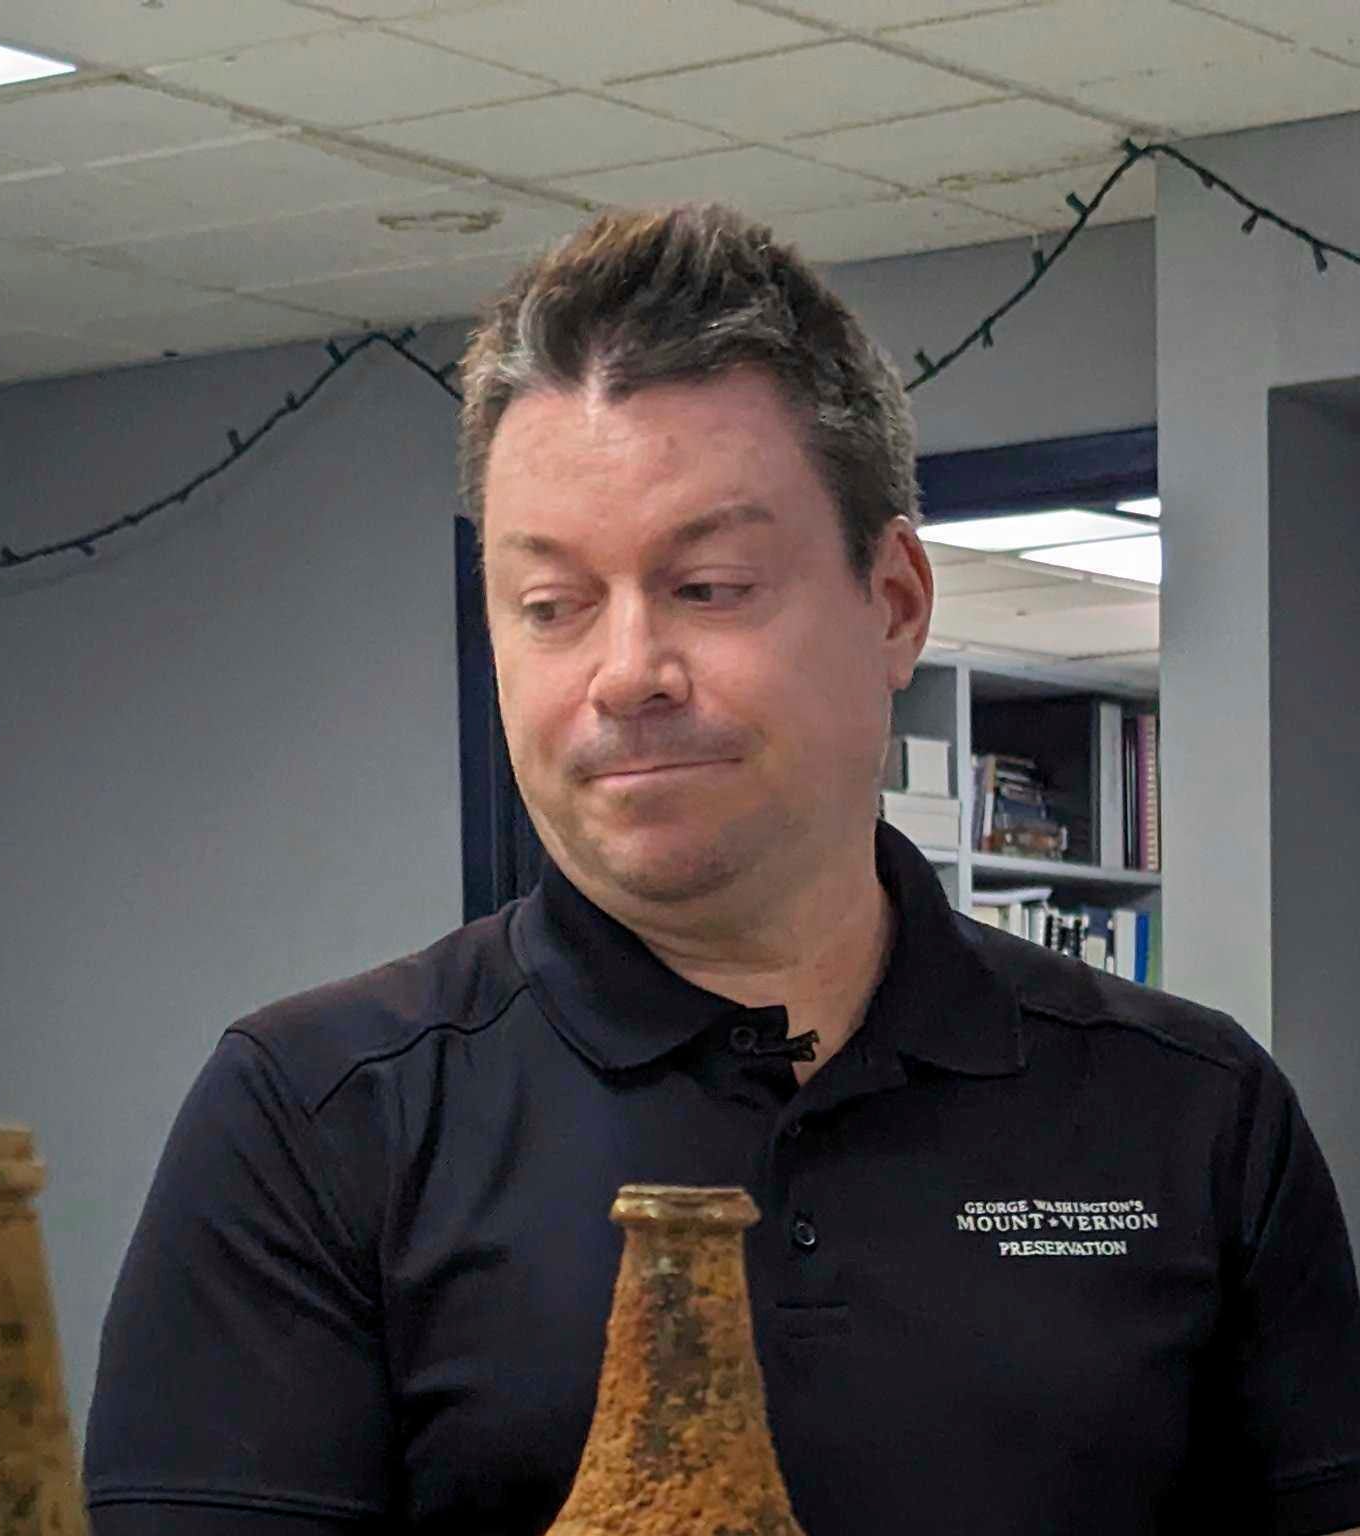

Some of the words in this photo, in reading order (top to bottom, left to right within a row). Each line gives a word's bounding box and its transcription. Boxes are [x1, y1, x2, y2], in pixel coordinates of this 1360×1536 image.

[964, 1200, 1028, 1215] GEORGE
[1033, 1199, 1144, 1214] WASHINGTON'S
[956, 1213, 1043, 1232] MOUNT
[1064, 1213, 1159, 1232] VERNON
[999, 1240, 1127, 1256] PRESERVATION
